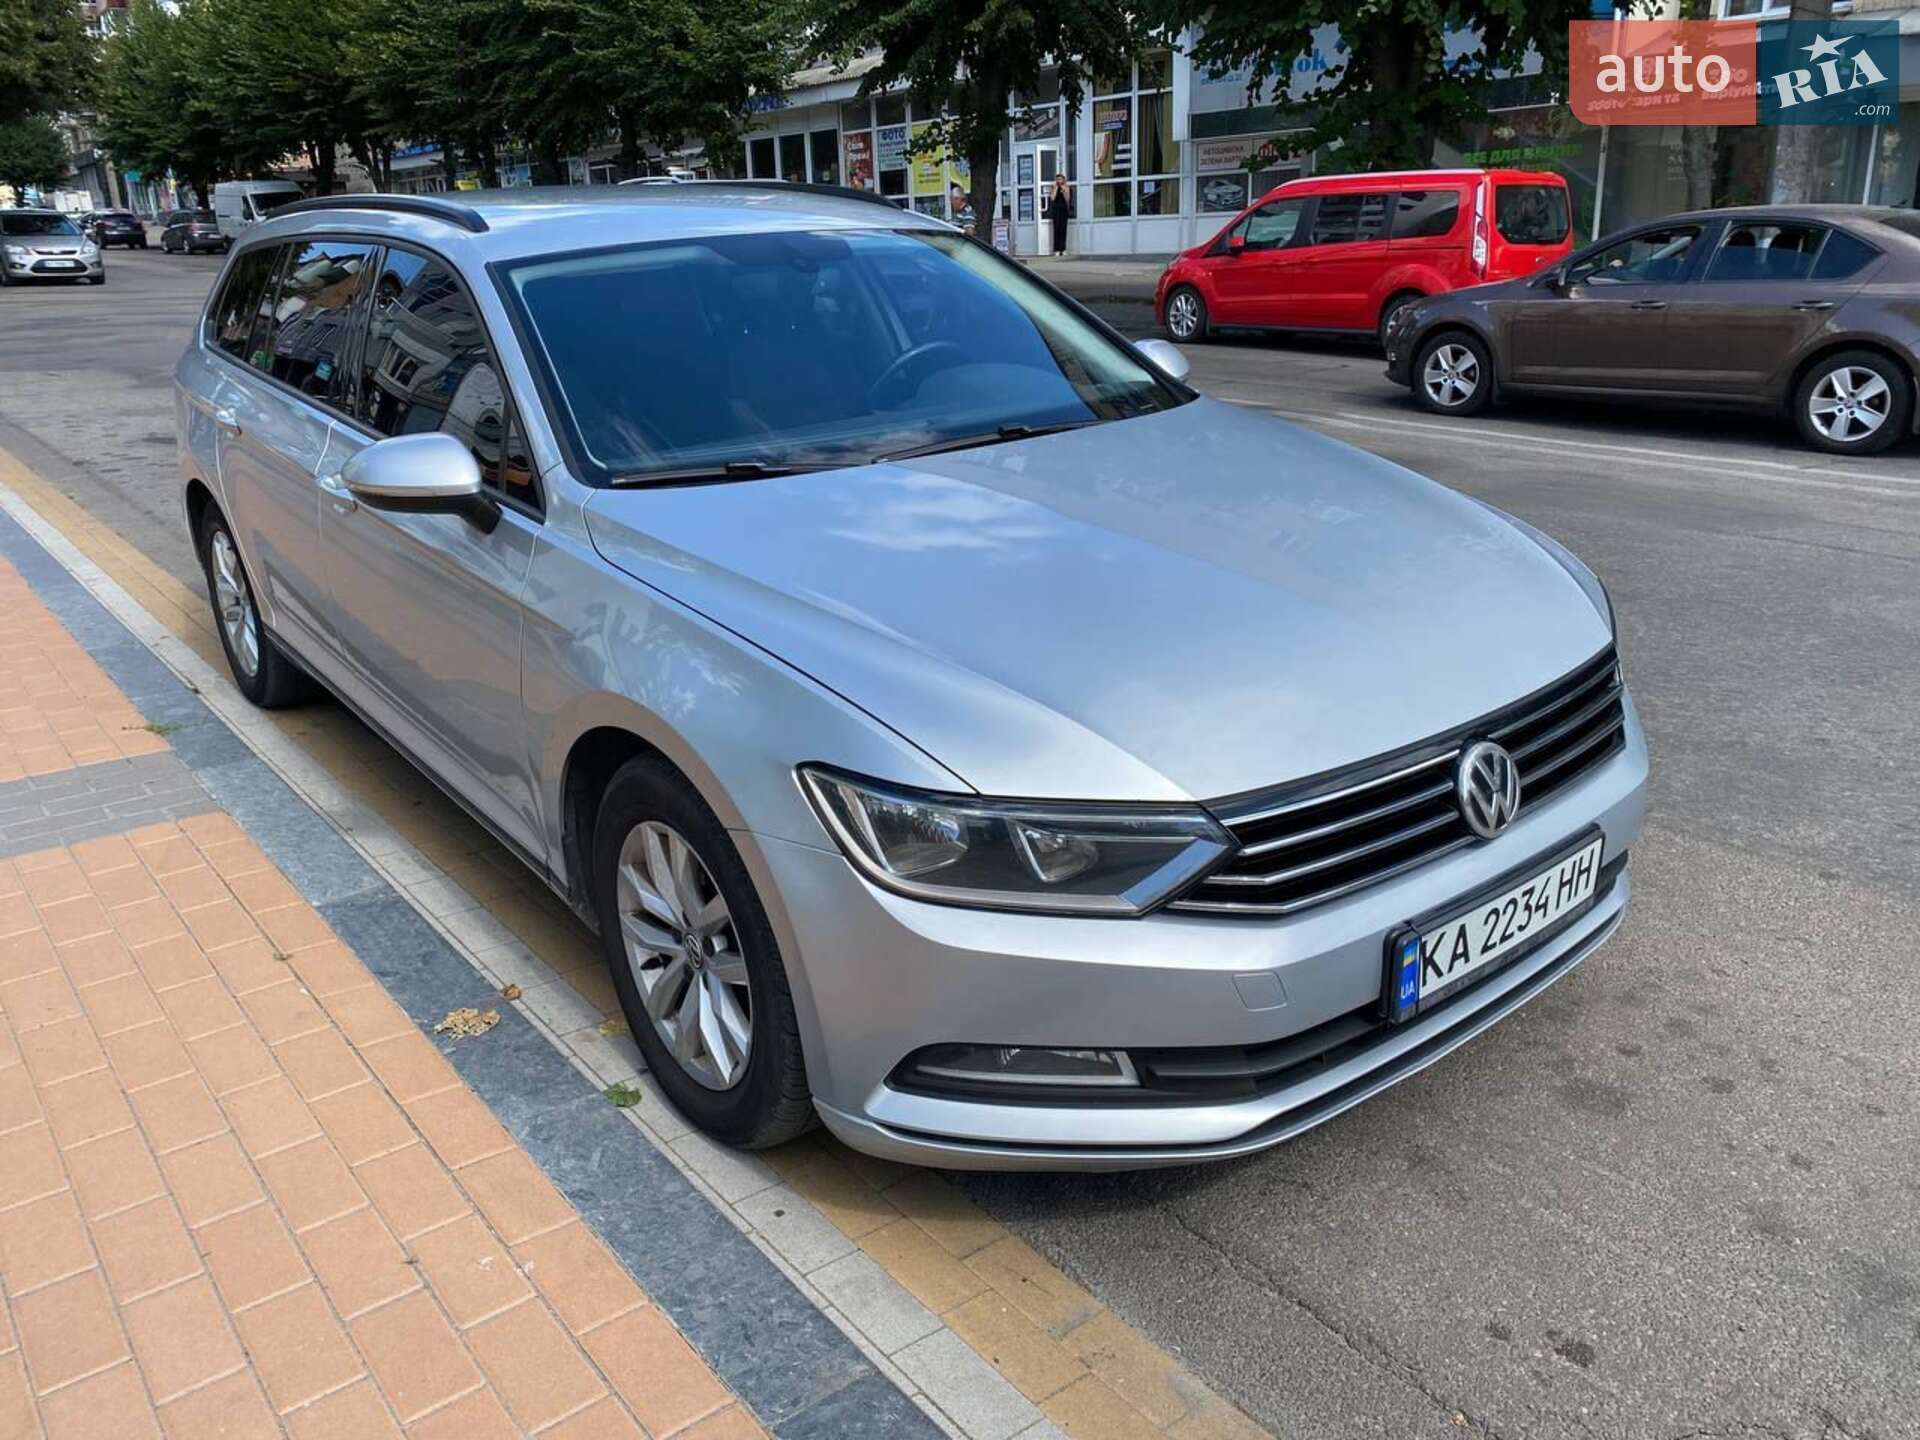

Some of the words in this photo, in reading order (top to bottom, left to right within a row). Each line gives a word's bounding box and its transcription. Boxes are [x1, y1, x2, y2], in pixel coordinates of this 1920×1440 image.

[1420, 923, 1471, 988] KA
[1480, 875, 1550, 955] 2234
[1555, 848, 1595, 910] HH
